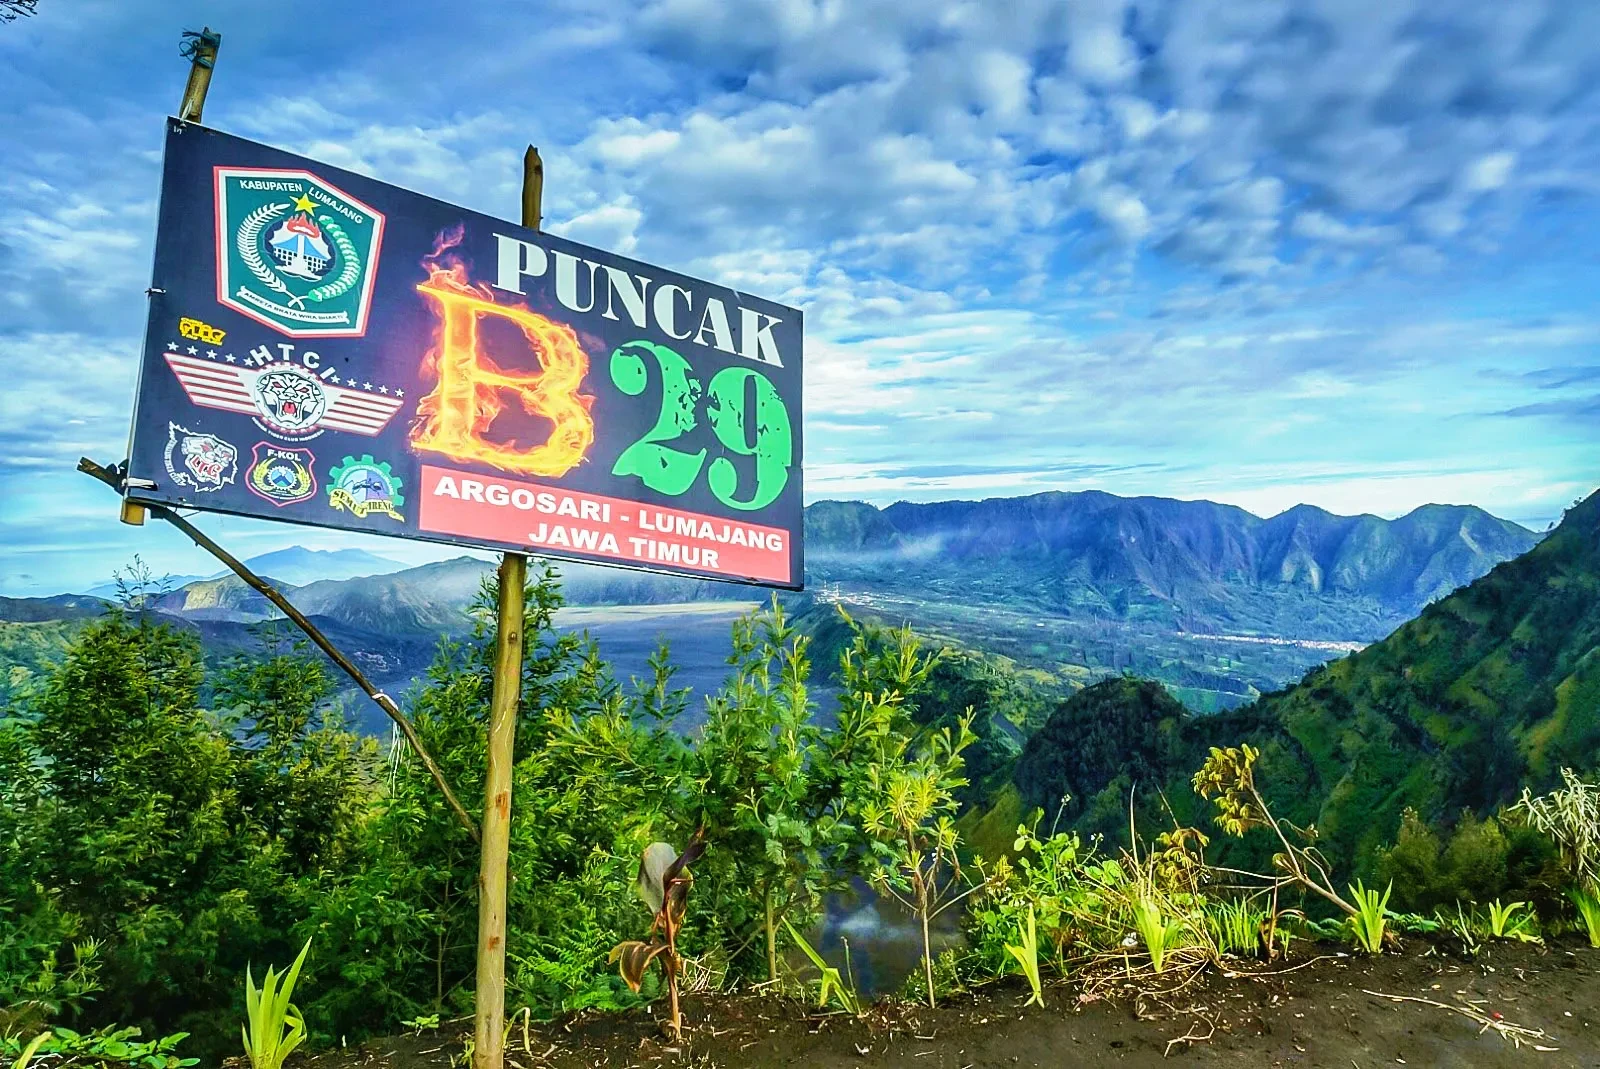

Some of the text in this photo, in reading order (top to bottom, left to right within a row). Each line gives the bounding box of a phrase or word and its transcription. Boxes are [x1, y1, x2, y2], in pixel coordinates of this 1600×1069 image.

[240, 180, 364, 224] KABUPATEN LUMAJANG
[492, 233, 784, 368] PUNCAK
[250, 343, 336, 380] HTCI
[410, 276, 793, 511] B 29
[268, 448, 302, 461] F-KOL
[434, 476, 610, 523] ARGOSARI
[639, 510, 783, 552] LUMAJANG
[528, 523, 720, 569] JAWA TIMUR
